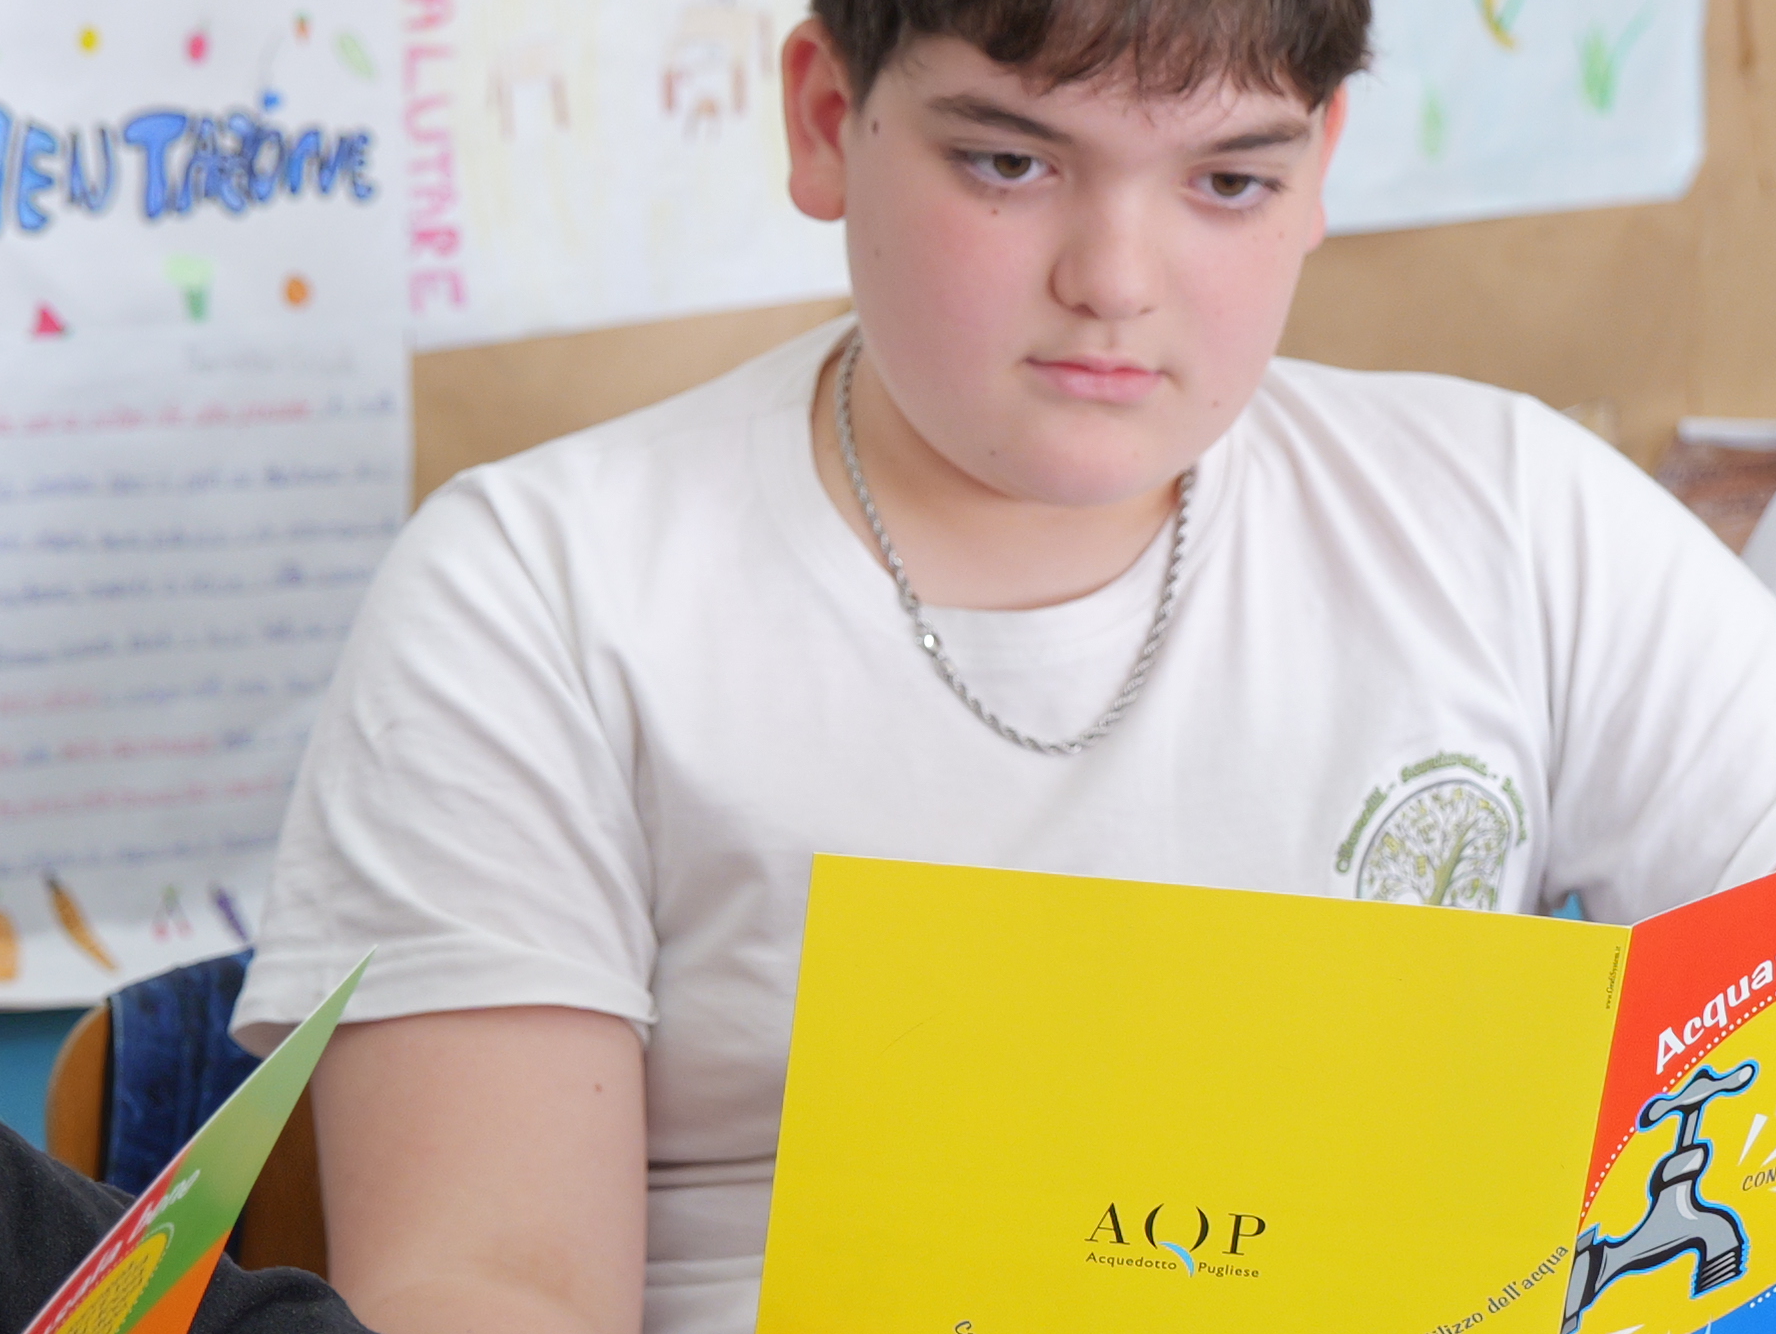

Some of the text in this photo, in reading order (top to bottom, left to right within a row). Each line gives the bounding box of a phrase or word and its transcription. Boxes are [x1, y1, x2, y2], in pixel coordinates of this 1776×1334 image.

[1084, 1201, 1267, 1275] AQP
[1085, 1251, 1260, 1279] Acquedotto Pugliese
[1485, 1241, 1569, 1316] dell'acqua
